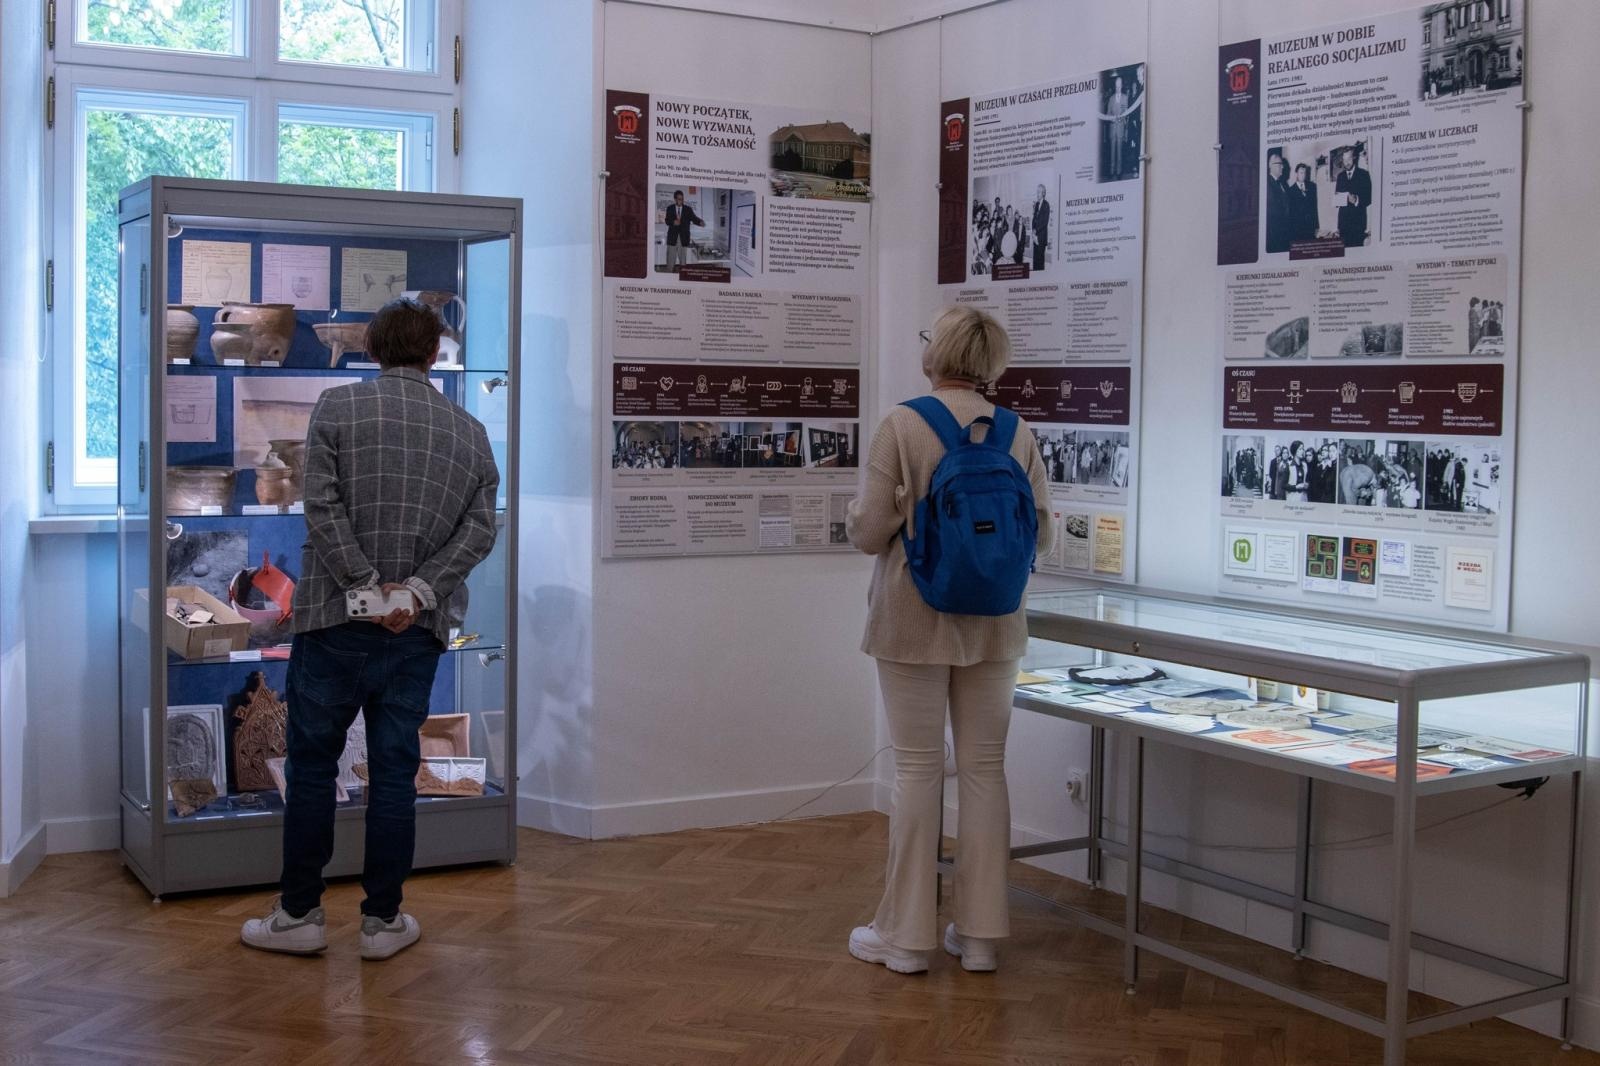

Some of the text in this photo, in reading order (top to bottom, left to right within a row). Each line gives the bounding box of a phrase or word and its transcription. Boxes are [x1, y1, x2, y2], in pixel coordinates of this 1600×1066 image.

[1268, 25, 1375, 56] MUZEUM W DOBIE
[1268, 39, 1406, 74] REALNEGO SOCJALIZMU
[1346, 79, 1368, 88] Muzeum
[975, 79, 1097, 112] MUZEUM W CZASACH PRZEŁOMU
[657, 102, 752, 121] NOWY POCZĄTEK,
[657, 117, 756, 136] NOWE WYZWANIA,
[1392, 124, 1478, 143] MUZEUM W LICZBACH
[656, 132, 689, 145] NOWA
[692, 135, 756, 150] TOŻSAMOŚĆ
[1066, 198, 1089, 207] MUZEUM
[1097, 194, 1124, 203] LICZBACH
